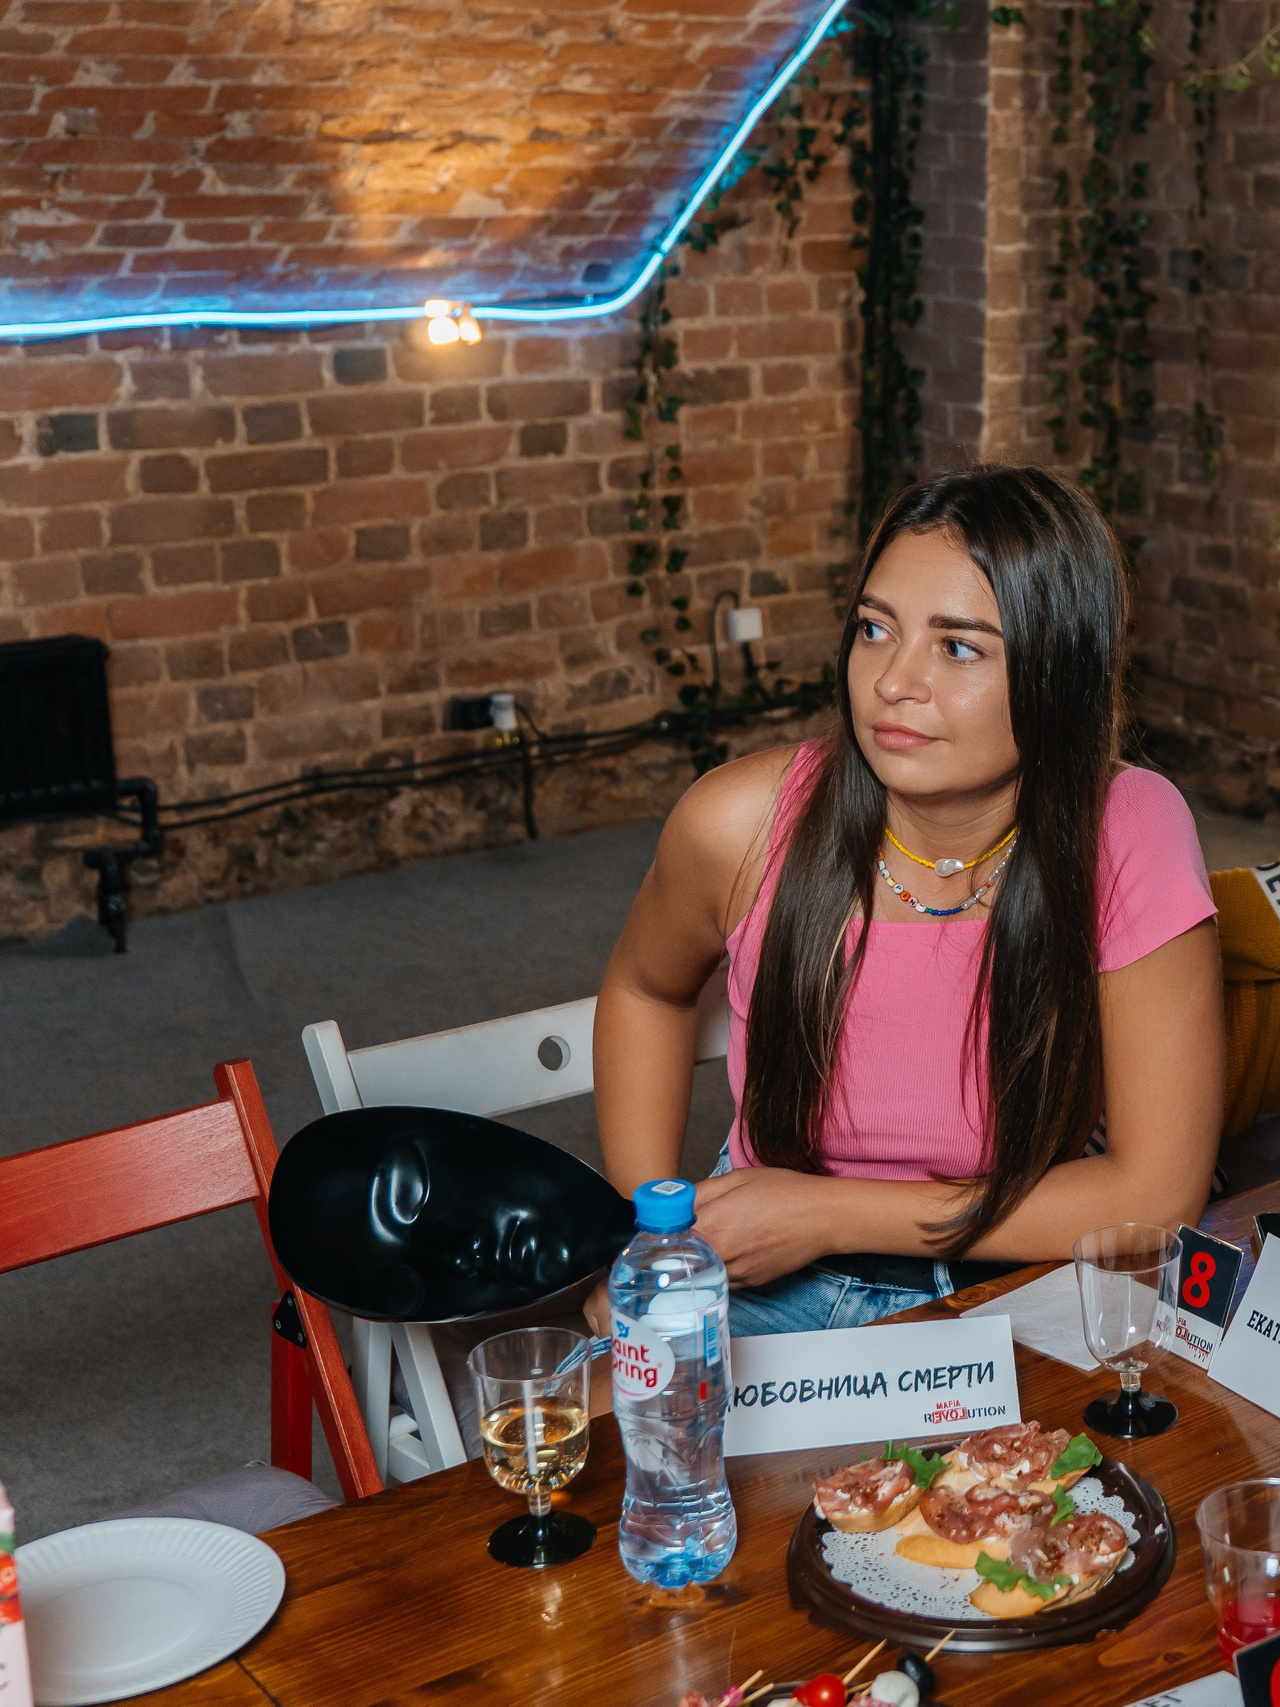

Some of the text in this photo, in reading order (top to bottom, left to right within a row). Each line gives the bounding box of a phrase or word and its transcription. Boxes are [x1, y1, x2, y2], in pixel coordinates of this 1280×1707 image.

[1182, 1251, 1216, 1308] 8
[612, 1338, 650, 1363] aint
[613, 1354, 658, 1388] ring
[728, 1361, 995, 1412] ЮБОВНИЦА СМЕРТИ
[936, 1400, 961, 1410] MAFIA
